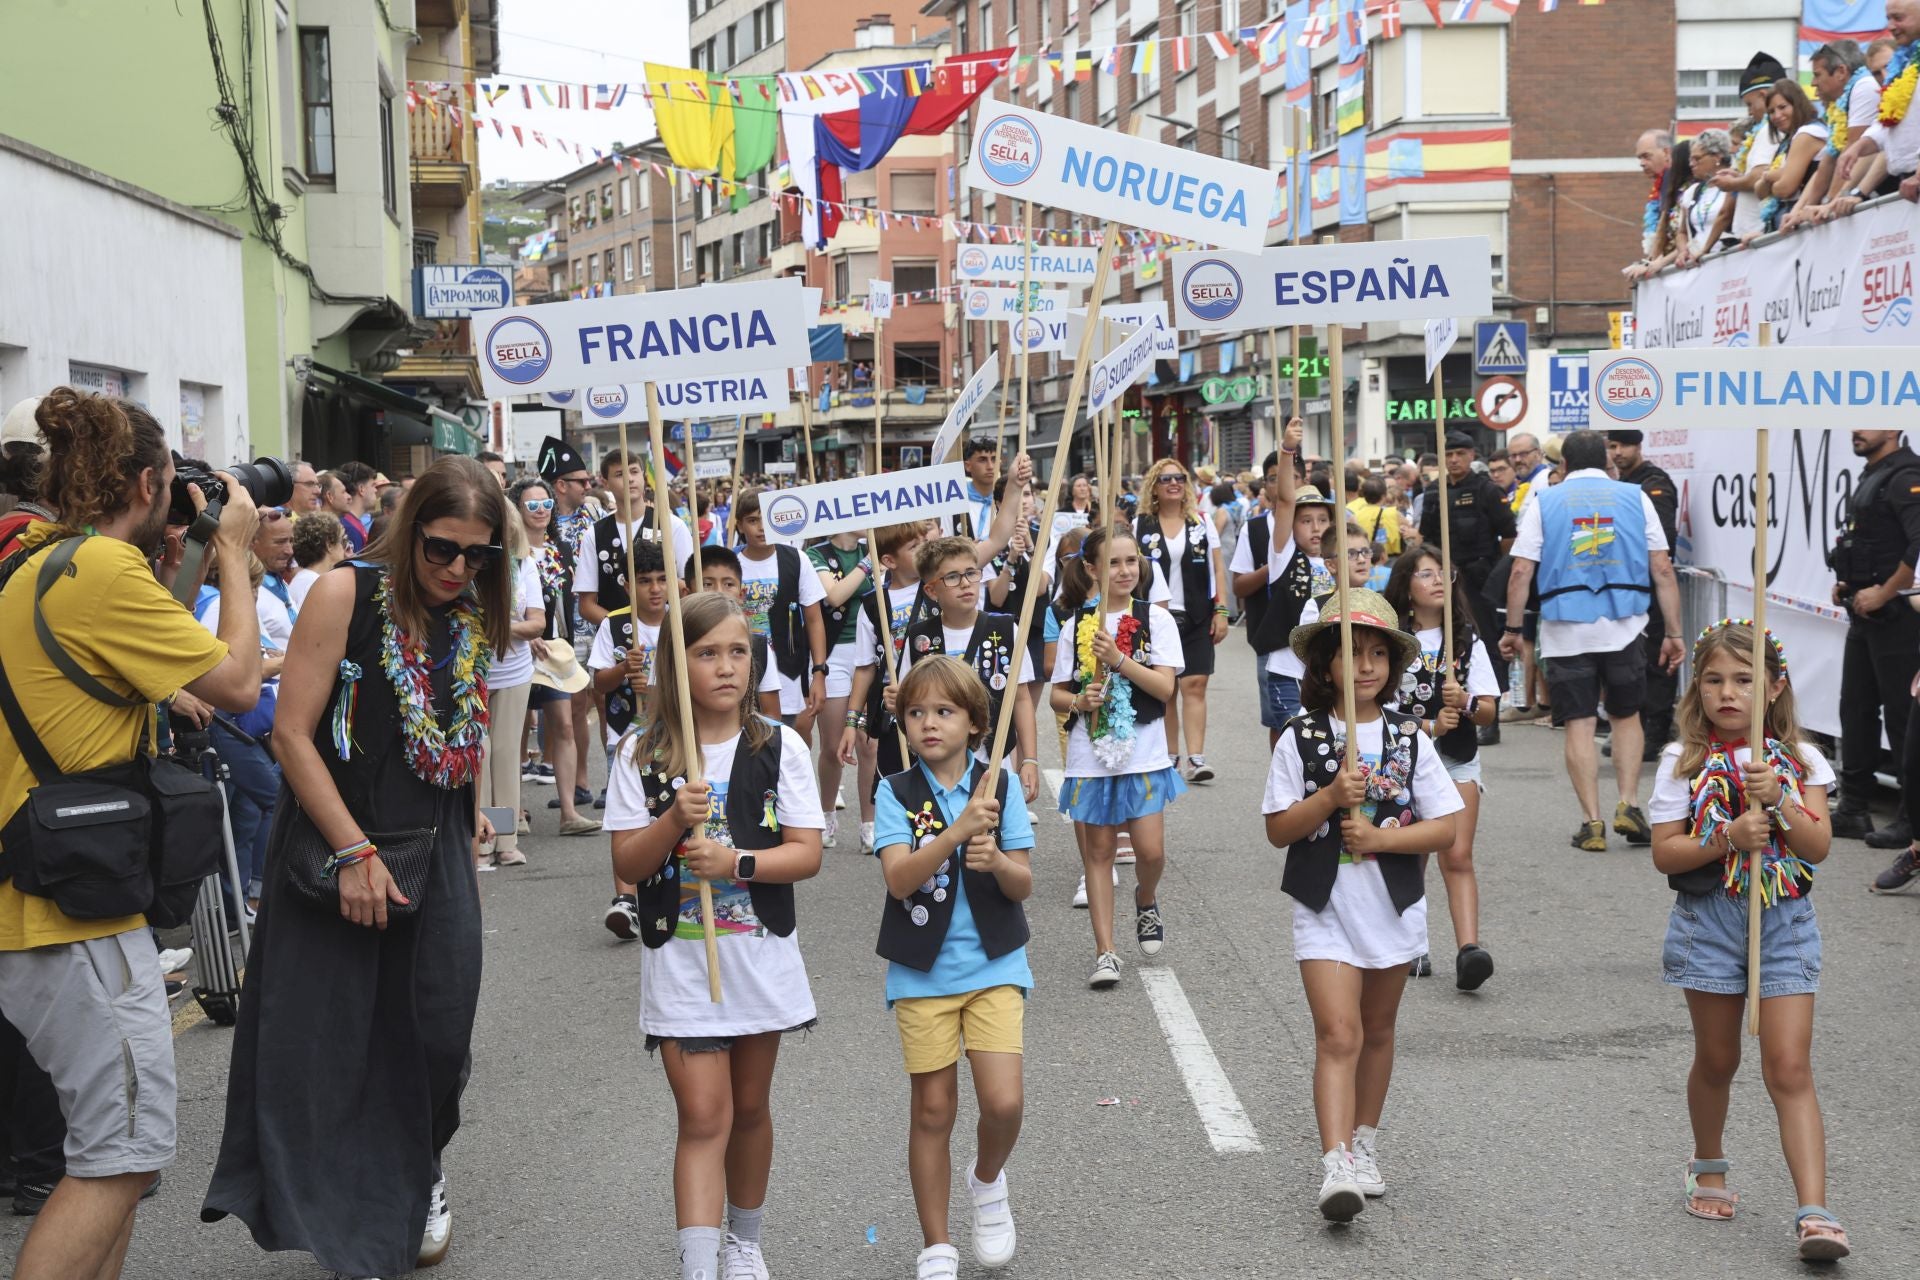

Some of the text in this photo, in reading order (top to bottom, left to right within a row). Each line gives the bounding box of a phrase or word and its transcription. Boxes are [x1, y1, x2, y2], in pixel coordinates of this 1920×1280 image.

[989, 144, 1029, 164] SELLA
[1062, 147, 1247, 226] NORUEGA
[991, 255, 1094, 273] AUSTRALIA
[1275, 258, 1449, 305] ESPAÑA
[429, 285, 500, 306] CAMPOAMOR
[1192, 287, 1233, 299] SELLA
[1863, 261, 1912, 305] SELLA
[1764, 258, 1845, 344] casa Marcial
[579, 309, 776, 365] FRANCIA
[1645, 327, 1662, 348] casa
[1666, 295, 1704, 348] Marcial
[1715, 302, 1750, 337] SELLA
[497, 346, 541, 361] SELLA
[1109, 333, 1153, 390] SUDÁFRICA
[1558, 358, 1588, 390] T
[1675, 371, 1920, 406] FINLANDIA
[593, 395, 622, 404] SELLA
[955, 378, 984, 427] CHILE
[1551, 391, 1588, 407] TAX
[1608, 387, 1651, 398] SELLA
[774, 511, 802, 522] SELLA
[814, 479, 964, 524] ALEMANIA
